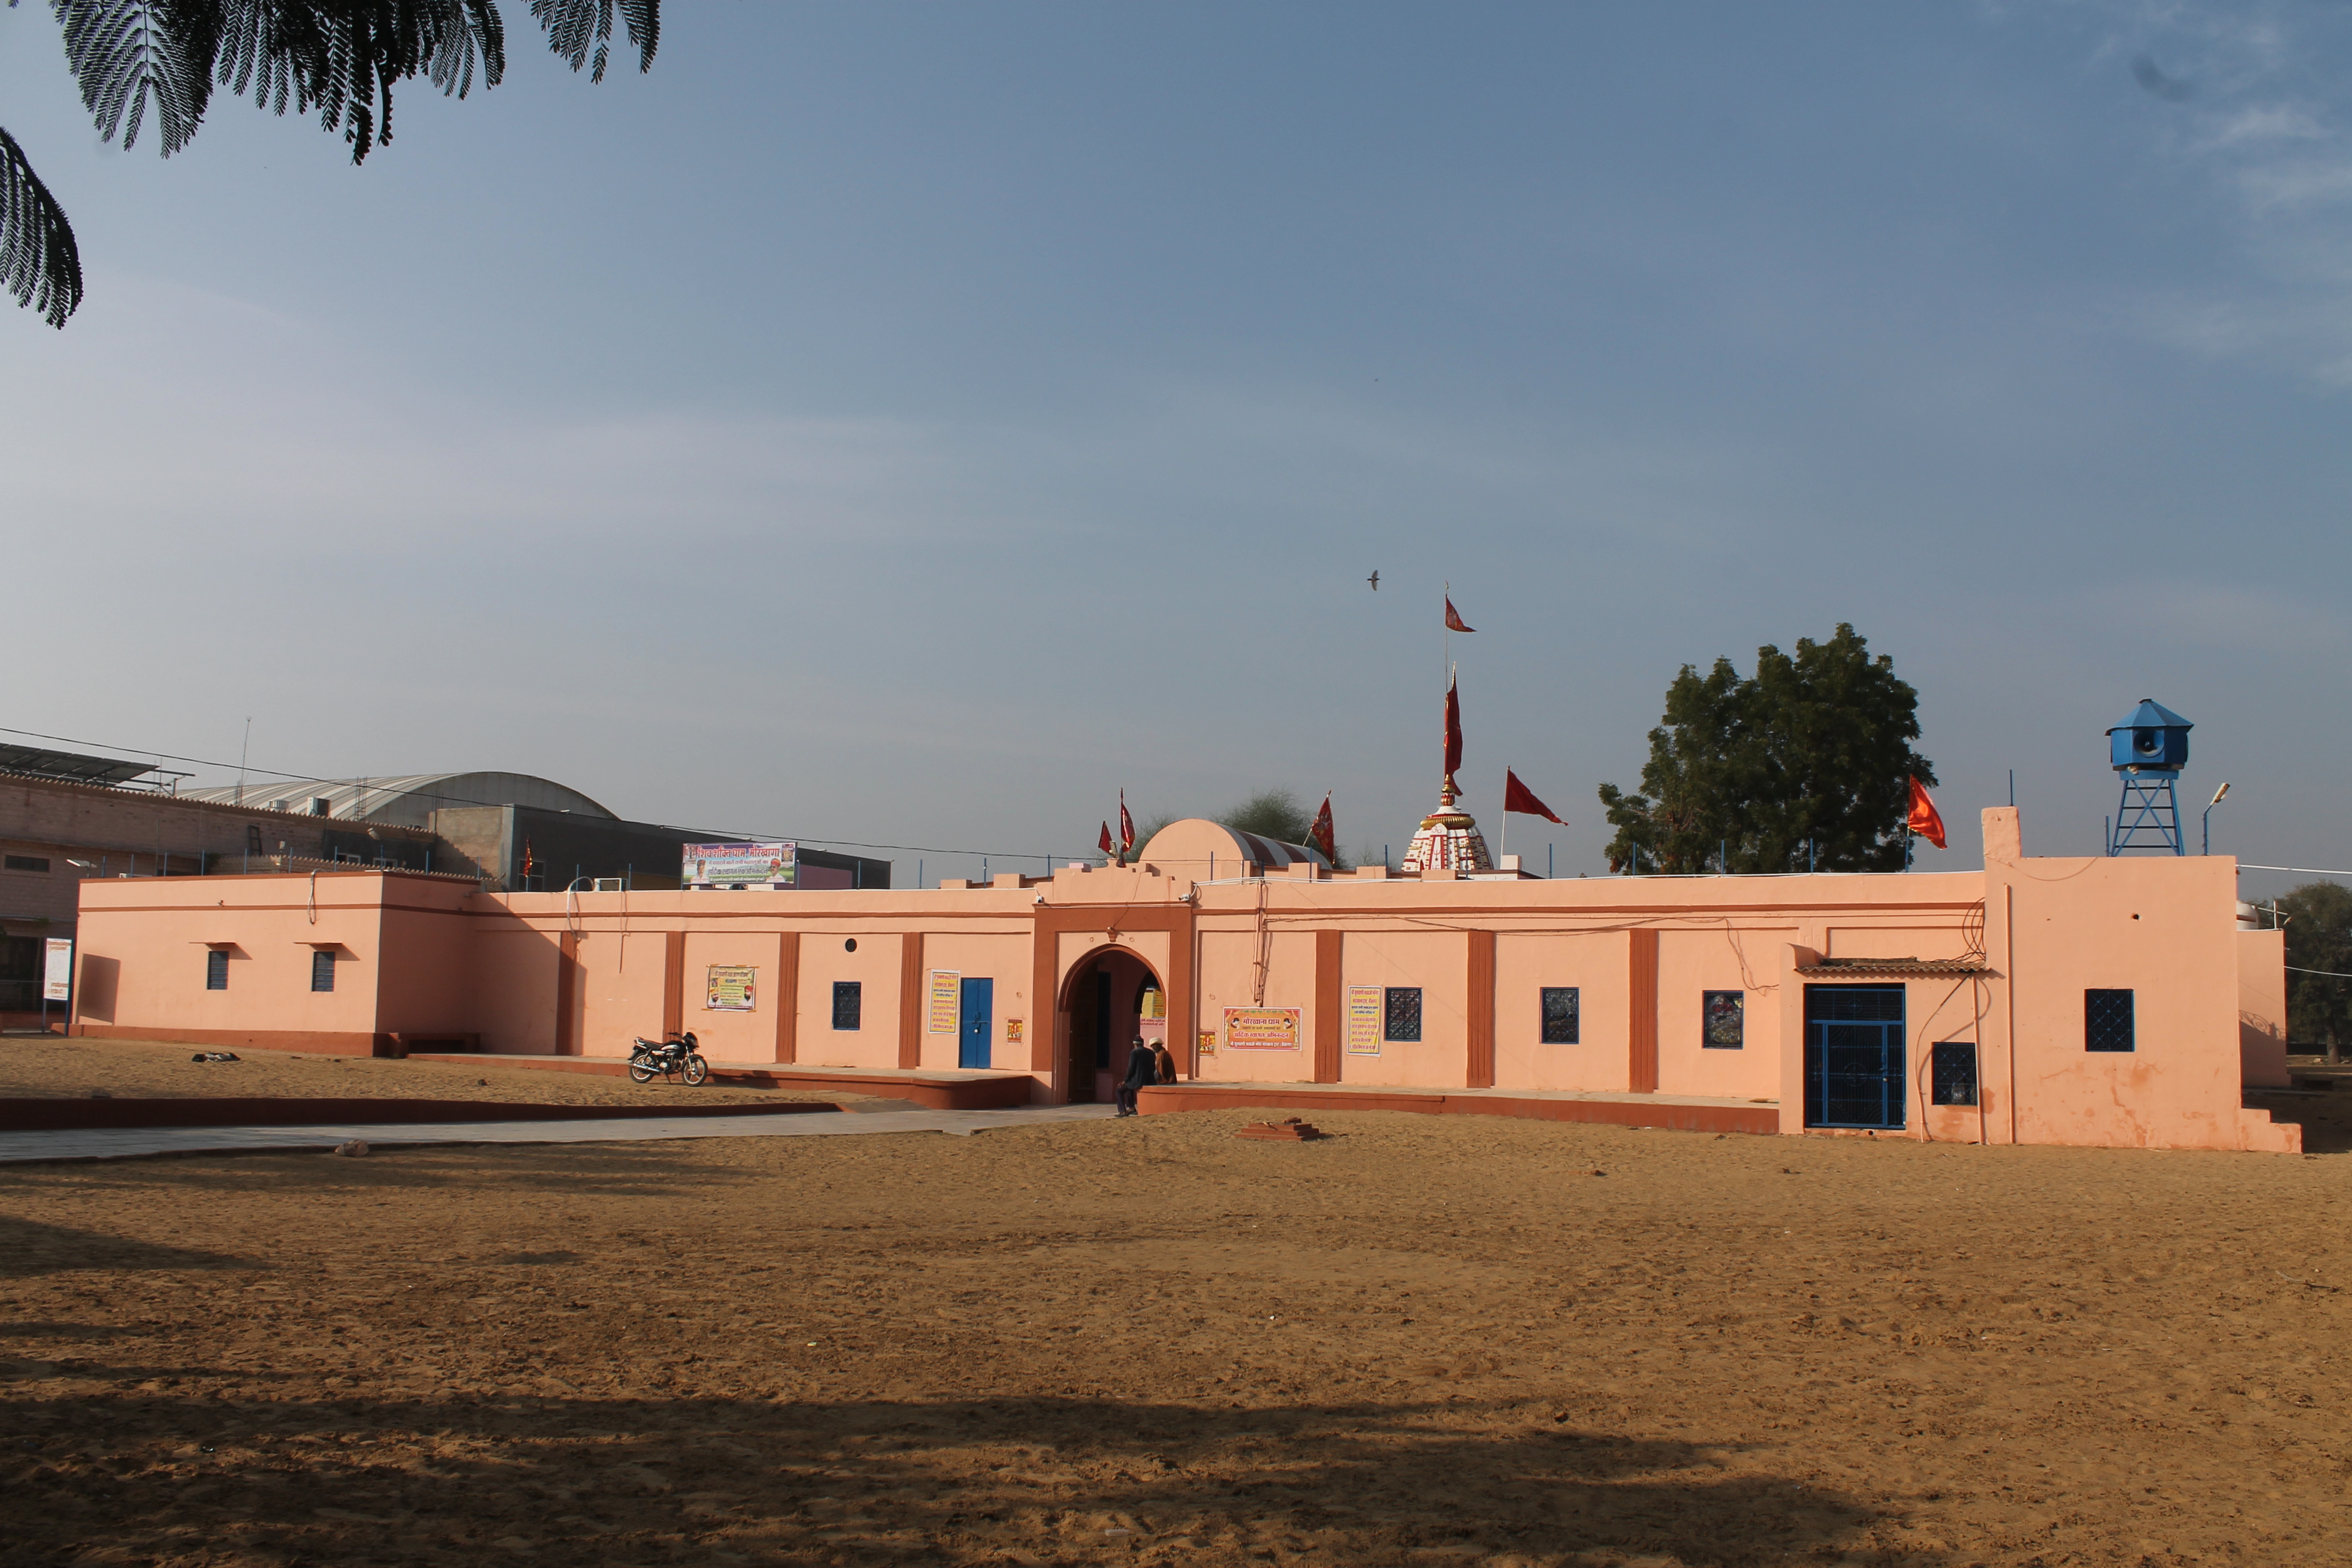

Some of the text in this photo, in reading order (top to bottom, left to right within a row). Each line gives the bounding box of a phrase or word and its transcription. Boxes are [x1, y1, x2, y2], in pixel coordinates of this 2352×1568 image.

[698, 846, 780, 858] शिव शक्ति धाम, मोरखाणा
